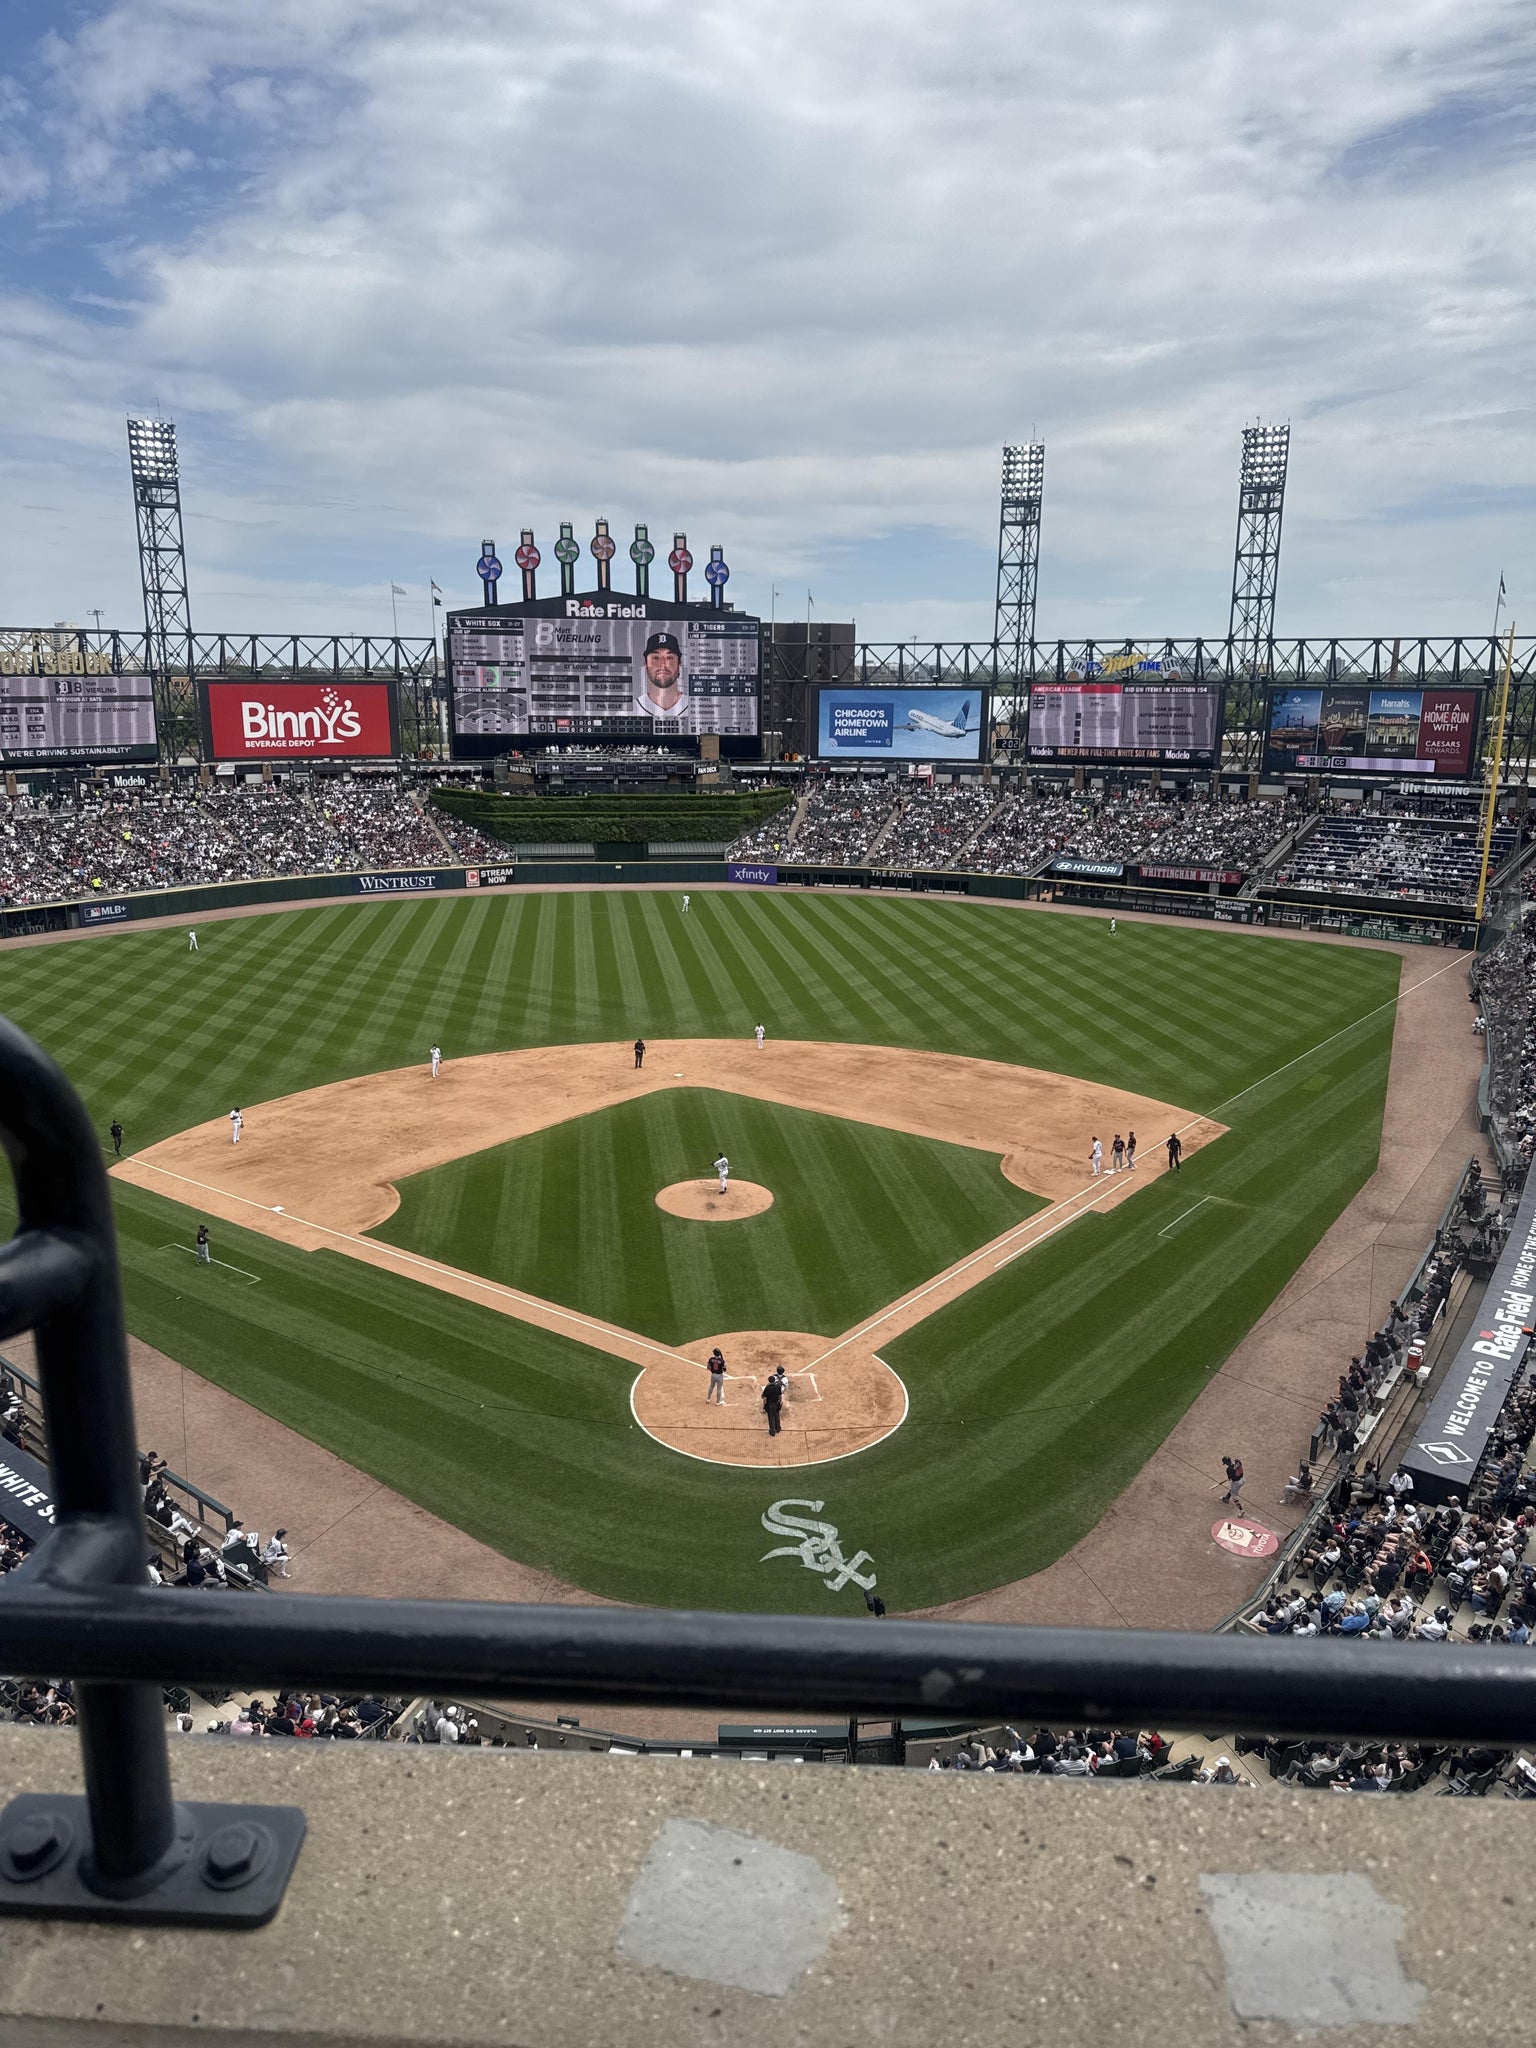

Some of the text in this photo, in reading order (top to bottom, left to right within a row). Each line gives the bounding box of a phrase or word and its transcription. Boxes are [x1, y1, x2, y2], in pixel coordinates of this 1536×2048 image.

[566, 599, 646, 618] Rate Field
[535, 623, 554, 646] 8
[556, 634, 602, 643] VIERLING
[1138, 661, 1161, 671] TIME
[74, 682, 82, 693] 8
[1434, 703, 1461, 711] HIT A
[834, 709, 885, 718] CHICAGO'S
[1424, 712, 1470, 724] HOME RUN
[834, 719, 889, 728] HOMETOWN
[1432, 724, 1459, 732] WITH
[834, 729, 867, 737] AIRLINE
[245, 739, 315, 748] BEVERAGE DEPOT
[8, 747, 131, 758] WE'RE DRIVING SUSTAINABILITY
[1031, 747, 1053, 756] Modelo
[1080, 748, 1089, 756] FOR
[1164, 750, 1190, 759] Modelo
[509, 765, 519, 773] FAN
[520, 766, 532, 774] DECK
[113, 775, 146, 787] Modelo
[1424, 784, 1470, 796] LANDING
[480, 868, 513, 878] STREAM
[735, 867, 770, 882] xfinity
[871, 869, 888, 877] THE
[1073, 864, 1118, 874] HYUNDAI
[488, 876, 507, 884] NOW
[1142, 868, 1227, 883] WHITTINGHAM MEATS
[359, 876, 435, 889] WINTRUST
[101, 905, 127, 916] MLB+
[1214, 911, 1233, 920] Rate
[1361, 930, 1386, 939] RUSH
[1510, 1263, 1534, 1289] HOME
[1494, 1290, 1534, 1326] Field
[1472, 1323, 1522, 1360] Rate
[1472, 1360, 1495, 1377] TO
[1443, 1376, 1488, 1436] WELCOME
[1253, 1533, 1271, 1555] TOYOTA
